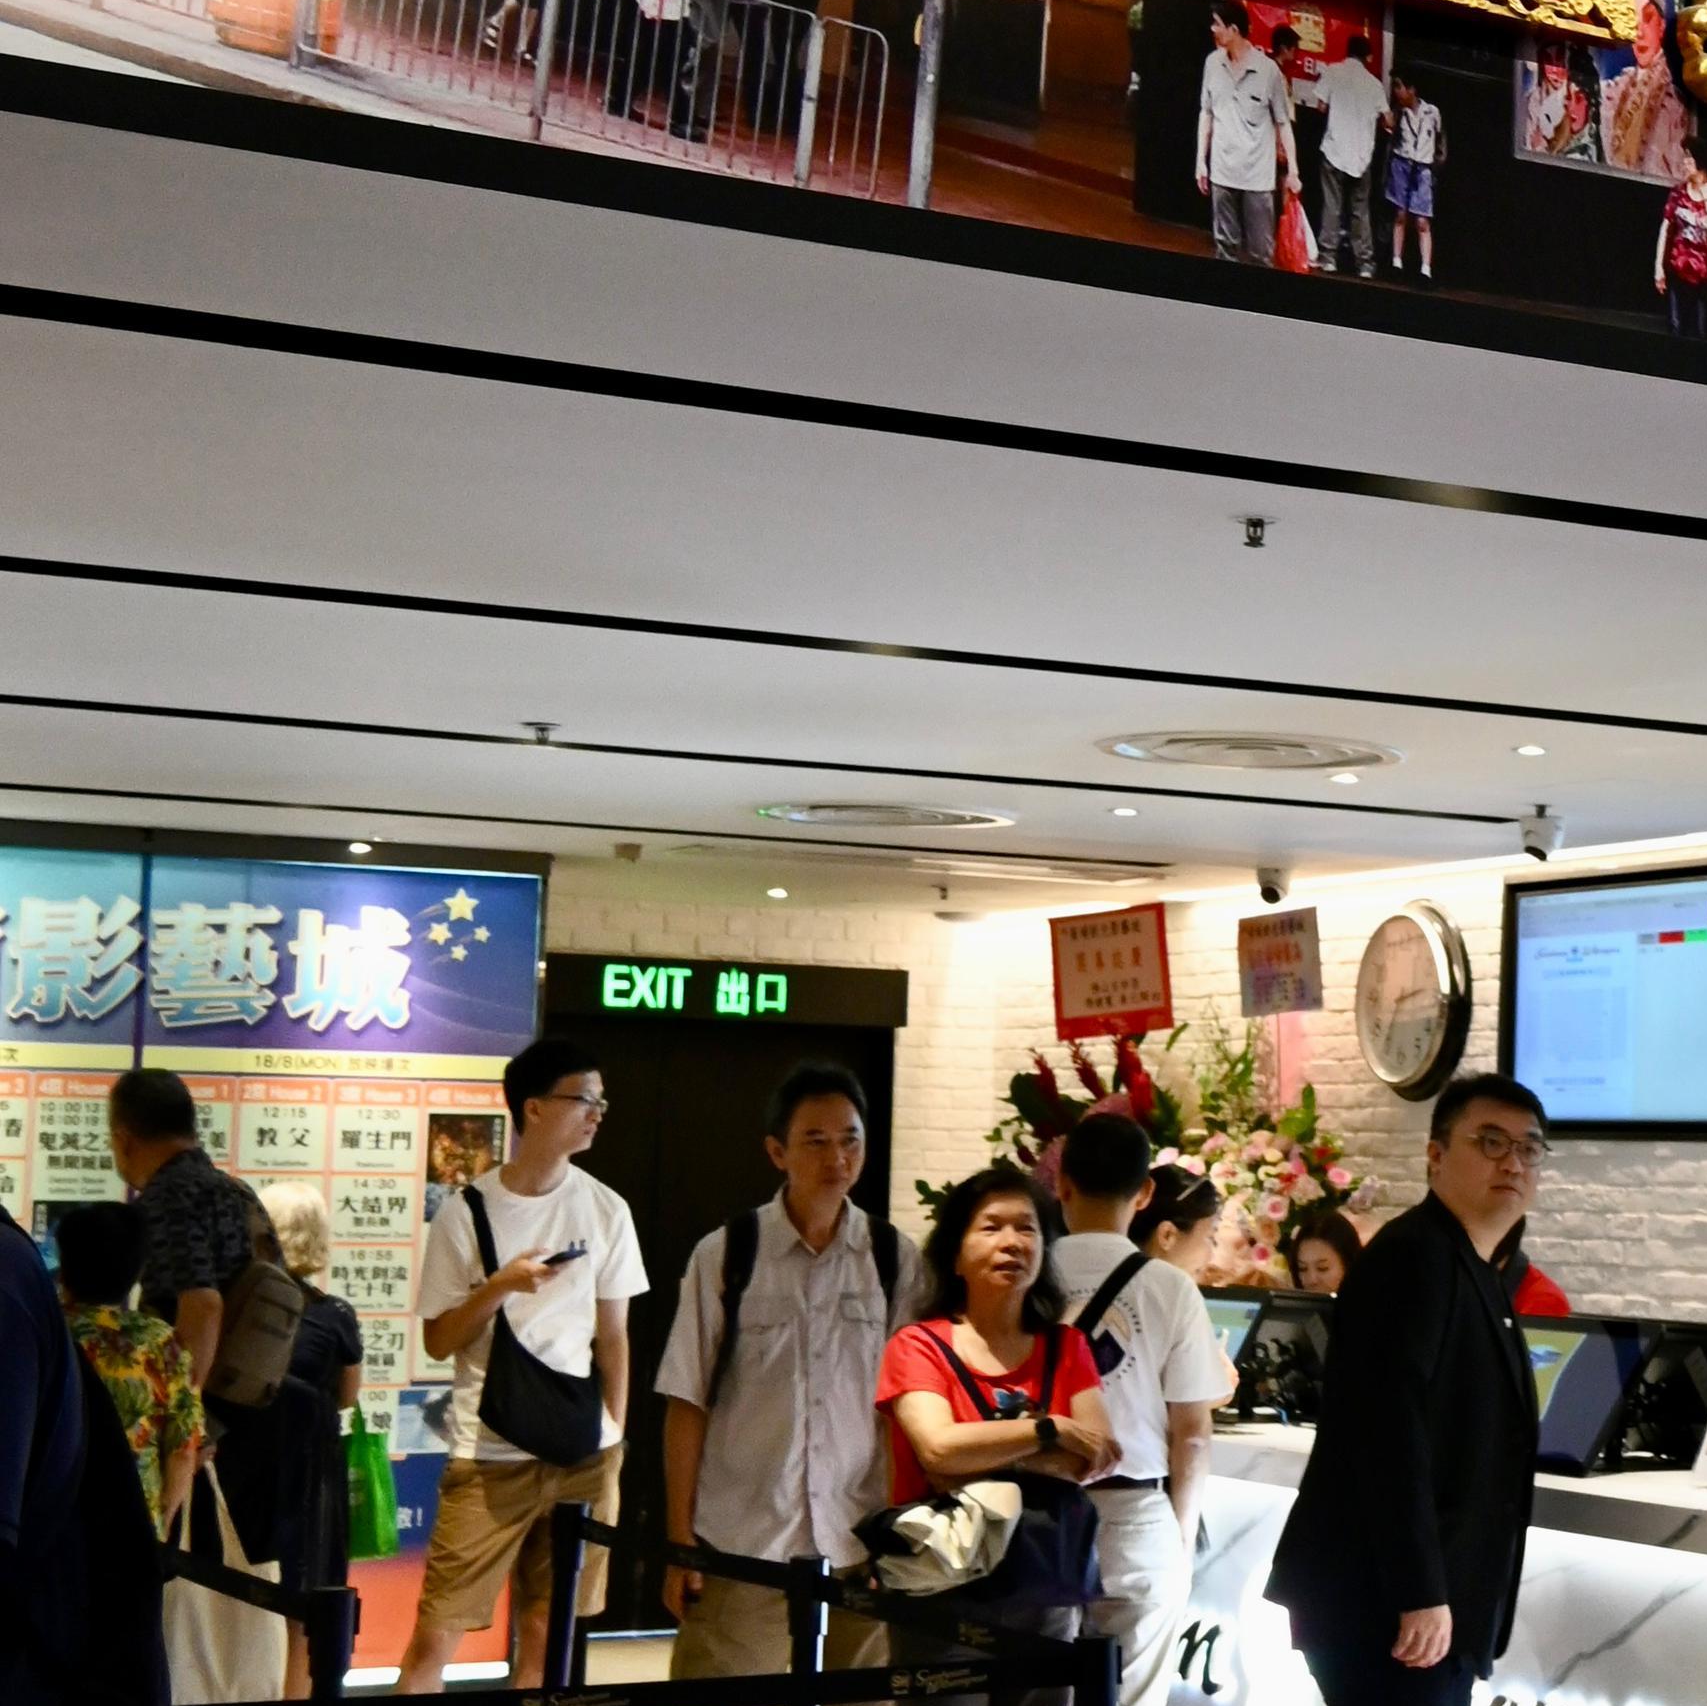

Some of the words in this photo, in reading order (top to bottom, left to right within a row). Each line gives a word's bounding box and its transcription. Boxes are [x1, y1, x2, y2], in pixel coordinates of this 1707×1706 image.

[0, 895, 412, 1031] 影藝城
[603, 964, 693, 1010] EXIT
[716, 969, 788, 1017] 出口
[256, 1127, 310, 1148] 教父
[341, 1130, 411, 1151] 羅生門
[337, 1195, 407, 1214] 大結界
[331, 1266, 407, 1281] 時光倒流
[343, 1282, 397, 1297] 七十年
[366, 1333, 404, 1351] 之刃
